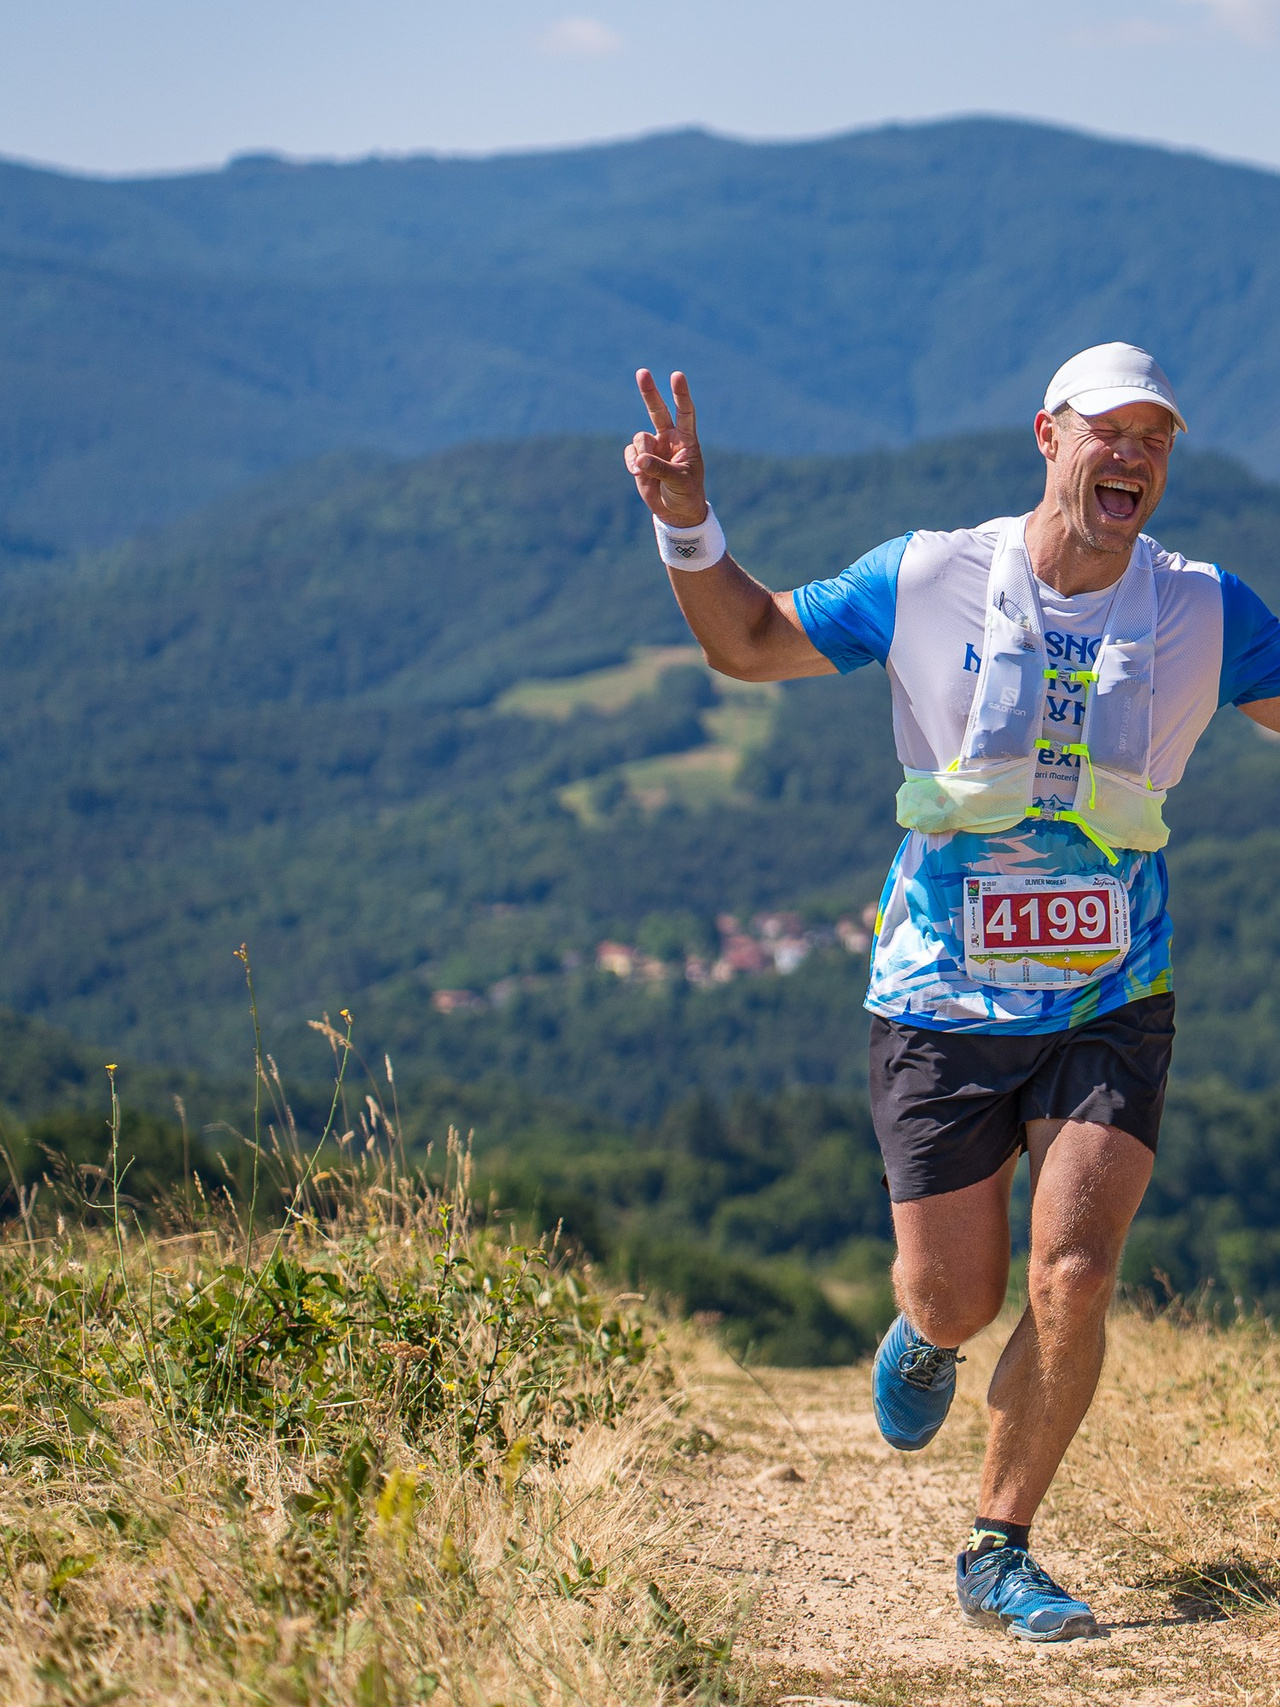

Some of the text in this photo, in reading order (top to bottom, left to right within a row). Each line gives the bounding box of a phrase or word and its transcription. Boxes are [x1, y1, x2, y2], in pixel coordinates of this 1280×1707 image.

[987, 702, 1027, 717] salomon
[1024, 878, 1067, 886] OLIVIER MOREAU
[985, 896, 1107, 942] 4199
